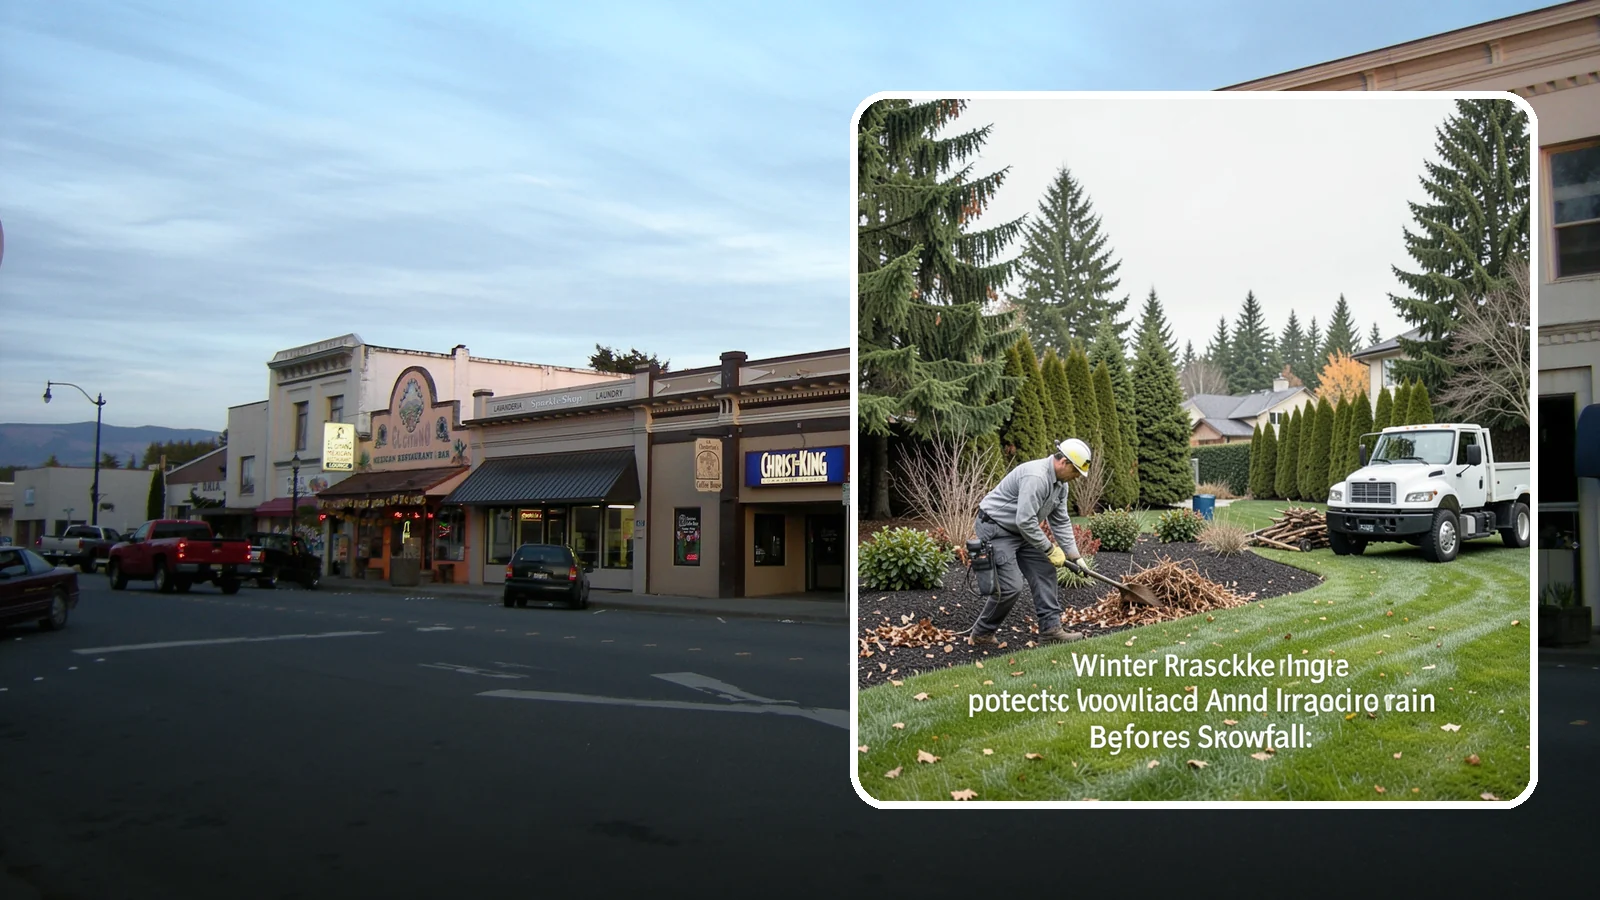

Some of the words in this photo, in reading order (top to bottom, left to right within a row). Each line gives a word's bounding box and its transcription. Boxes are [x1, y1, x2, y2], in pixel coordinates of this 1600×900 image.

[562, 394, 582, 406] Shop
[595, 389, 623, 400] LAUNDRY
[493, 402, 522, 413] LAVANDERIA
[397, 451, 433, 462] RESTAURANT
[437, 450, 450, 459] BAR
